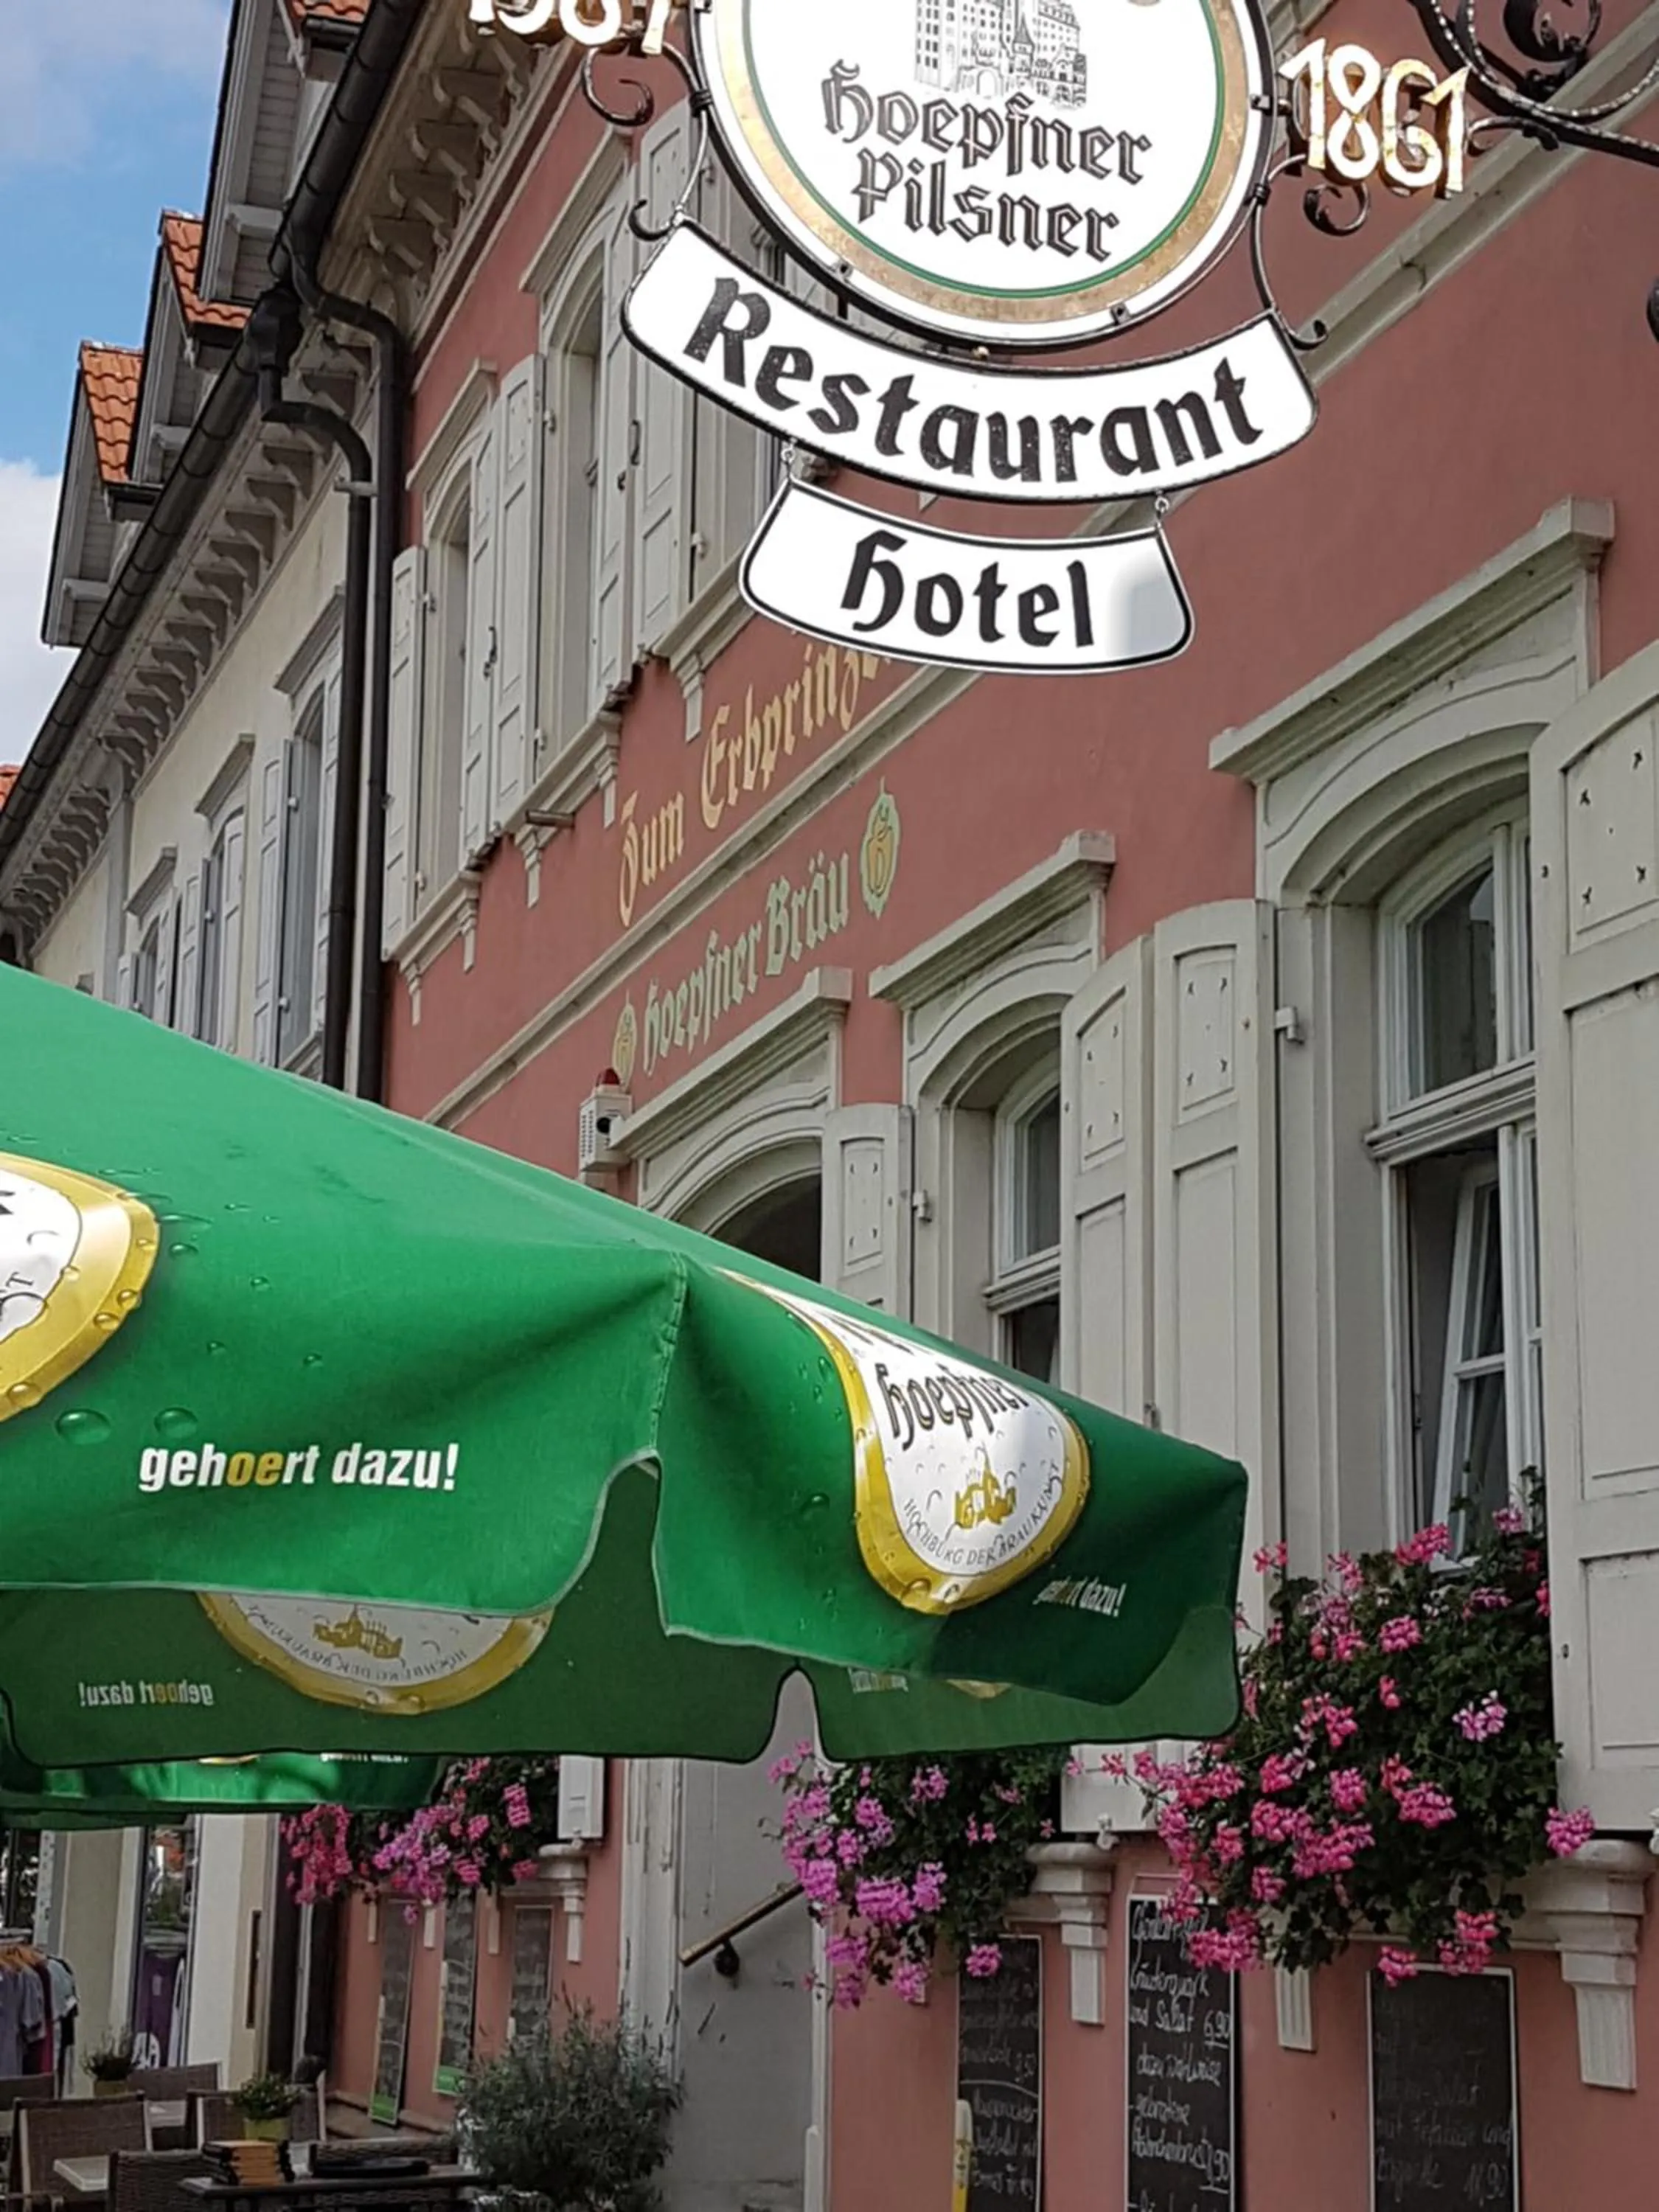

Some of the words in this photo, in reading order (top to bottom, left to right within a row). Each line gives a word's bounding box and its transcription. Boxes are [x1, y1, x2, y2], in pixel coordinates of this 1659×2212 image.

[821, 59, 1152, 186] Hoepfner
[1280, 38, 1472, 198] 1861
[851, 147, 1120, 262] Pilsner
[683, 276, 1264, 484] Restaurant
[841, 529, 1094, 648] Hotel
[619, 790, 685, 928] Zum
[700, 641, 891, 830] Erbprinz
[643, 931, 762, 1078] Hoepfner
[765, 849, 849, 976] Bräu
[138, 1443, 320, 1492] gehoert
[332, 1442, 459, 1491] dazu!
[966, 1547, 998, 1568] DER
